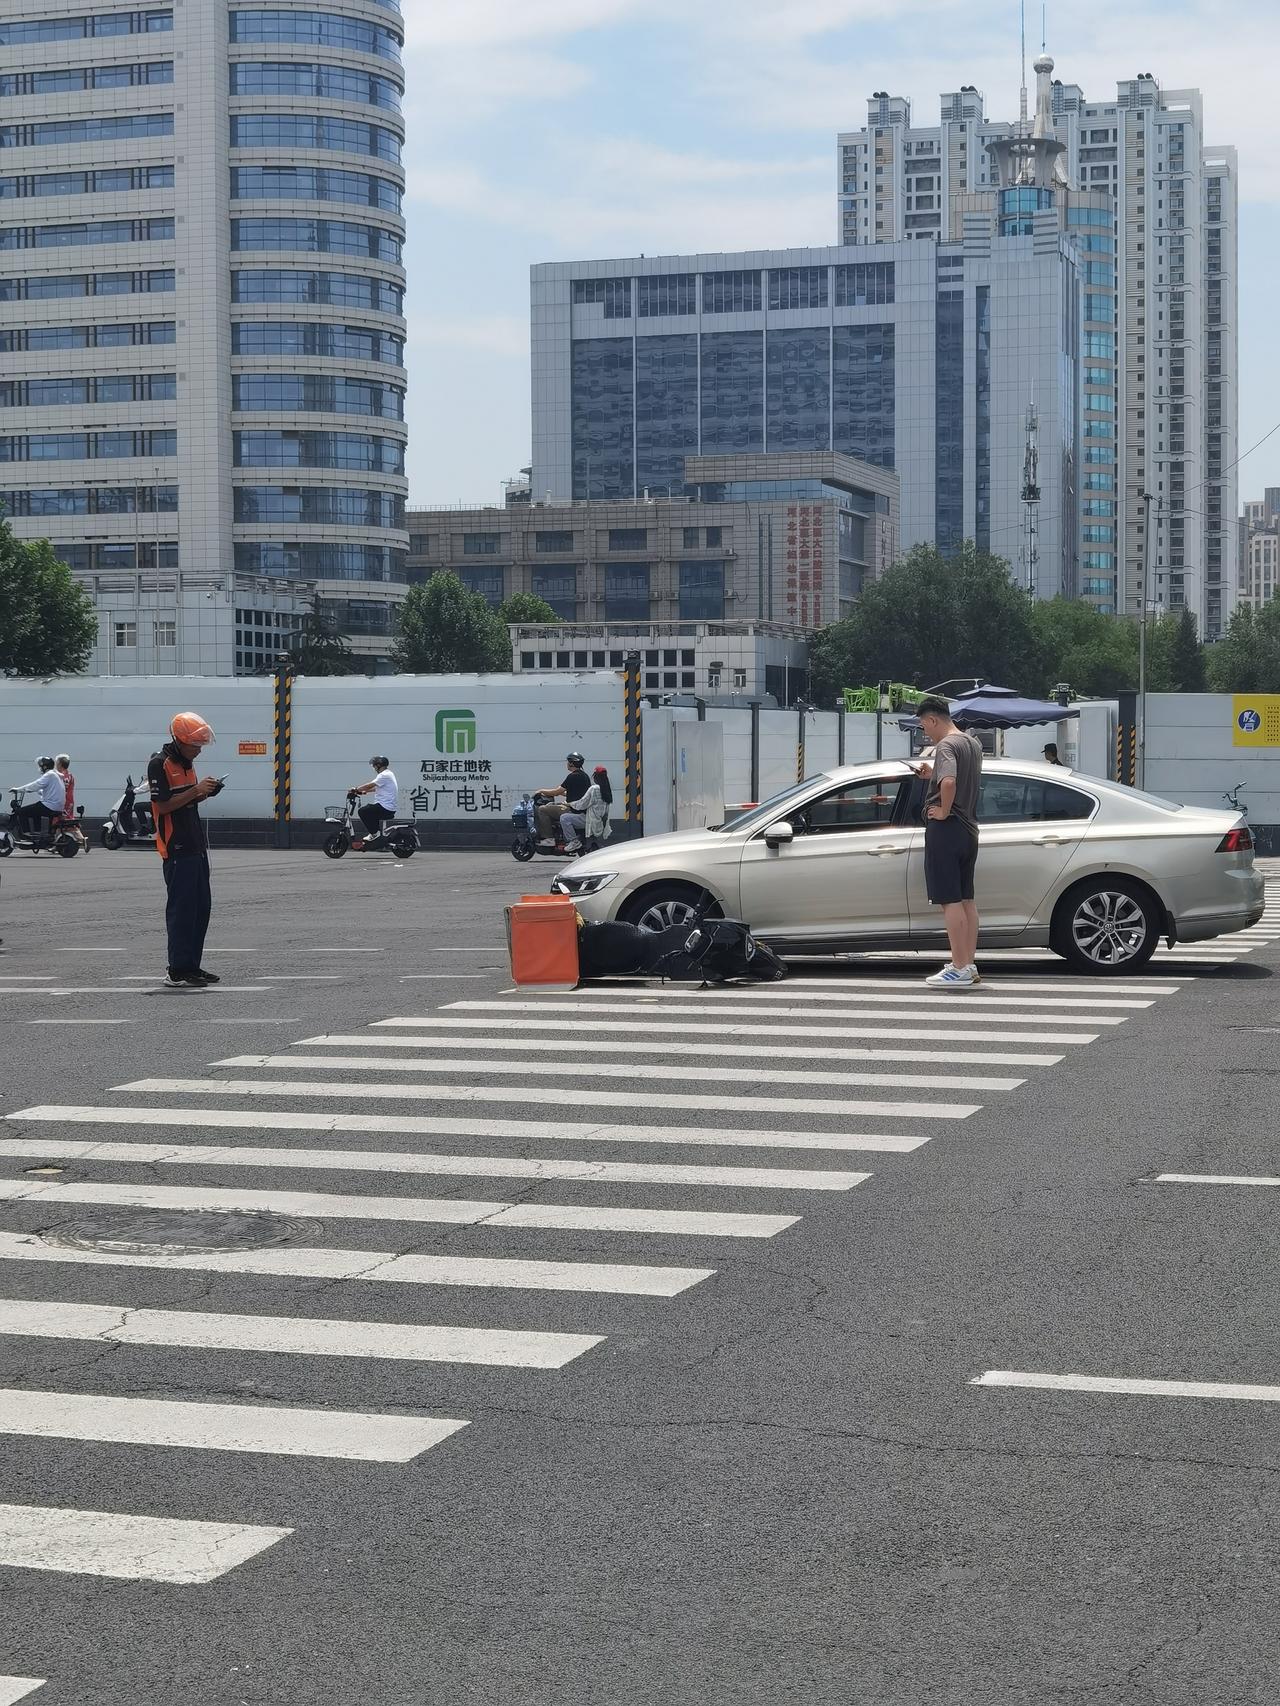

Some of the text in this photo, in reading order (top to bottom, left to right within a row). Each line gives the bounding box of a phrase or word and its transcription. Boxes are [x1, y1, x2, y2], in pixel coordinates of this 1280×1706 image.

[420, 760, 492, 772] 石家庄地铁
[423, 774, 467, 782] Shijiazhuang
[409, 785, 503, 812] 省广电站
